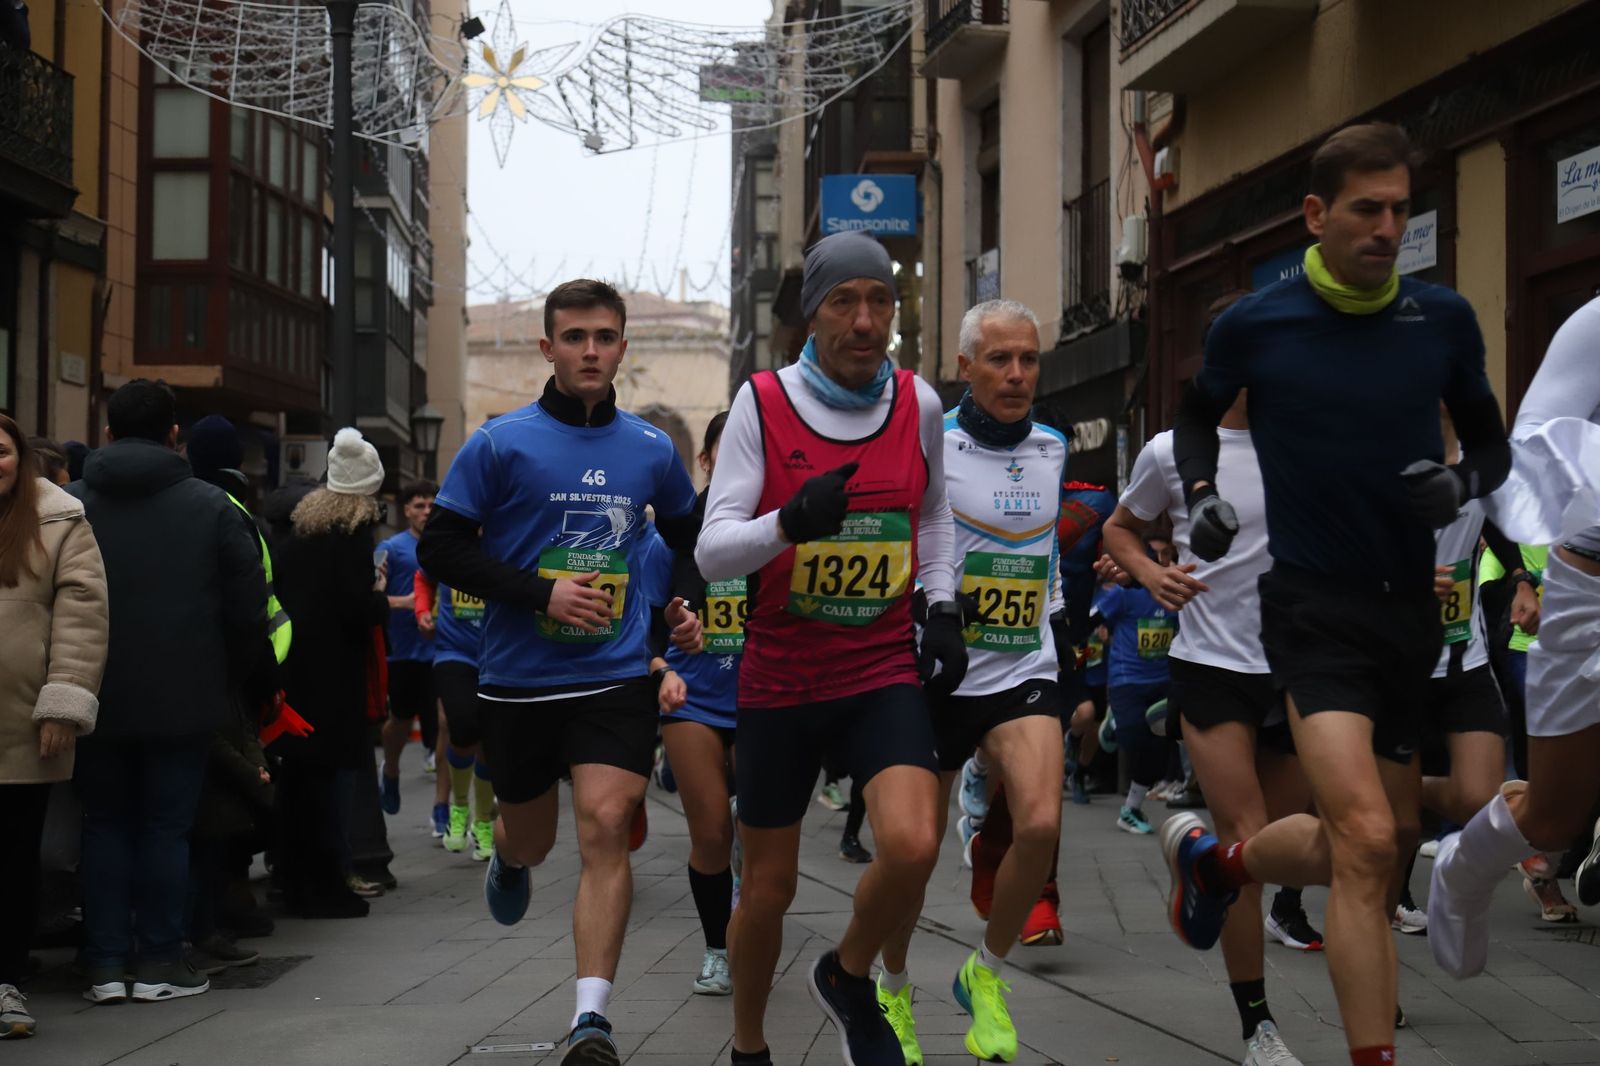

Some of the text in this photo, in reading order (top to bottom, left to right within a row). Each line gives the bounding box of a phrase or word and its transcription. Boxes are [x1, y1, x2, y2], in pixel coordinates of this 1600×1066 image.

[1561, 160, 1582, 188] La
[827, 217, 910, 231] Samsonite
[1412, 223, 1434, 240] mer
[581, 469, 607, 486] 46
[550, 493, 632, 505] SAN SILVESTRE 2025
[853, 527, 882, 535] RURAL
[567, 559, 610, 568] CAJA RURAL
[991, 564, 1034, 574] CAJA RURAL
[803, 554, 890, 597] 1324
[822, 604, 887, 618] CAJA RUR
[968, 586, 1037, 627] 1255
[712, 638, 735, 647] CAJA
[983, 632, 1011, 645] CAJA
[1140, 632, 1169, 649] 620
